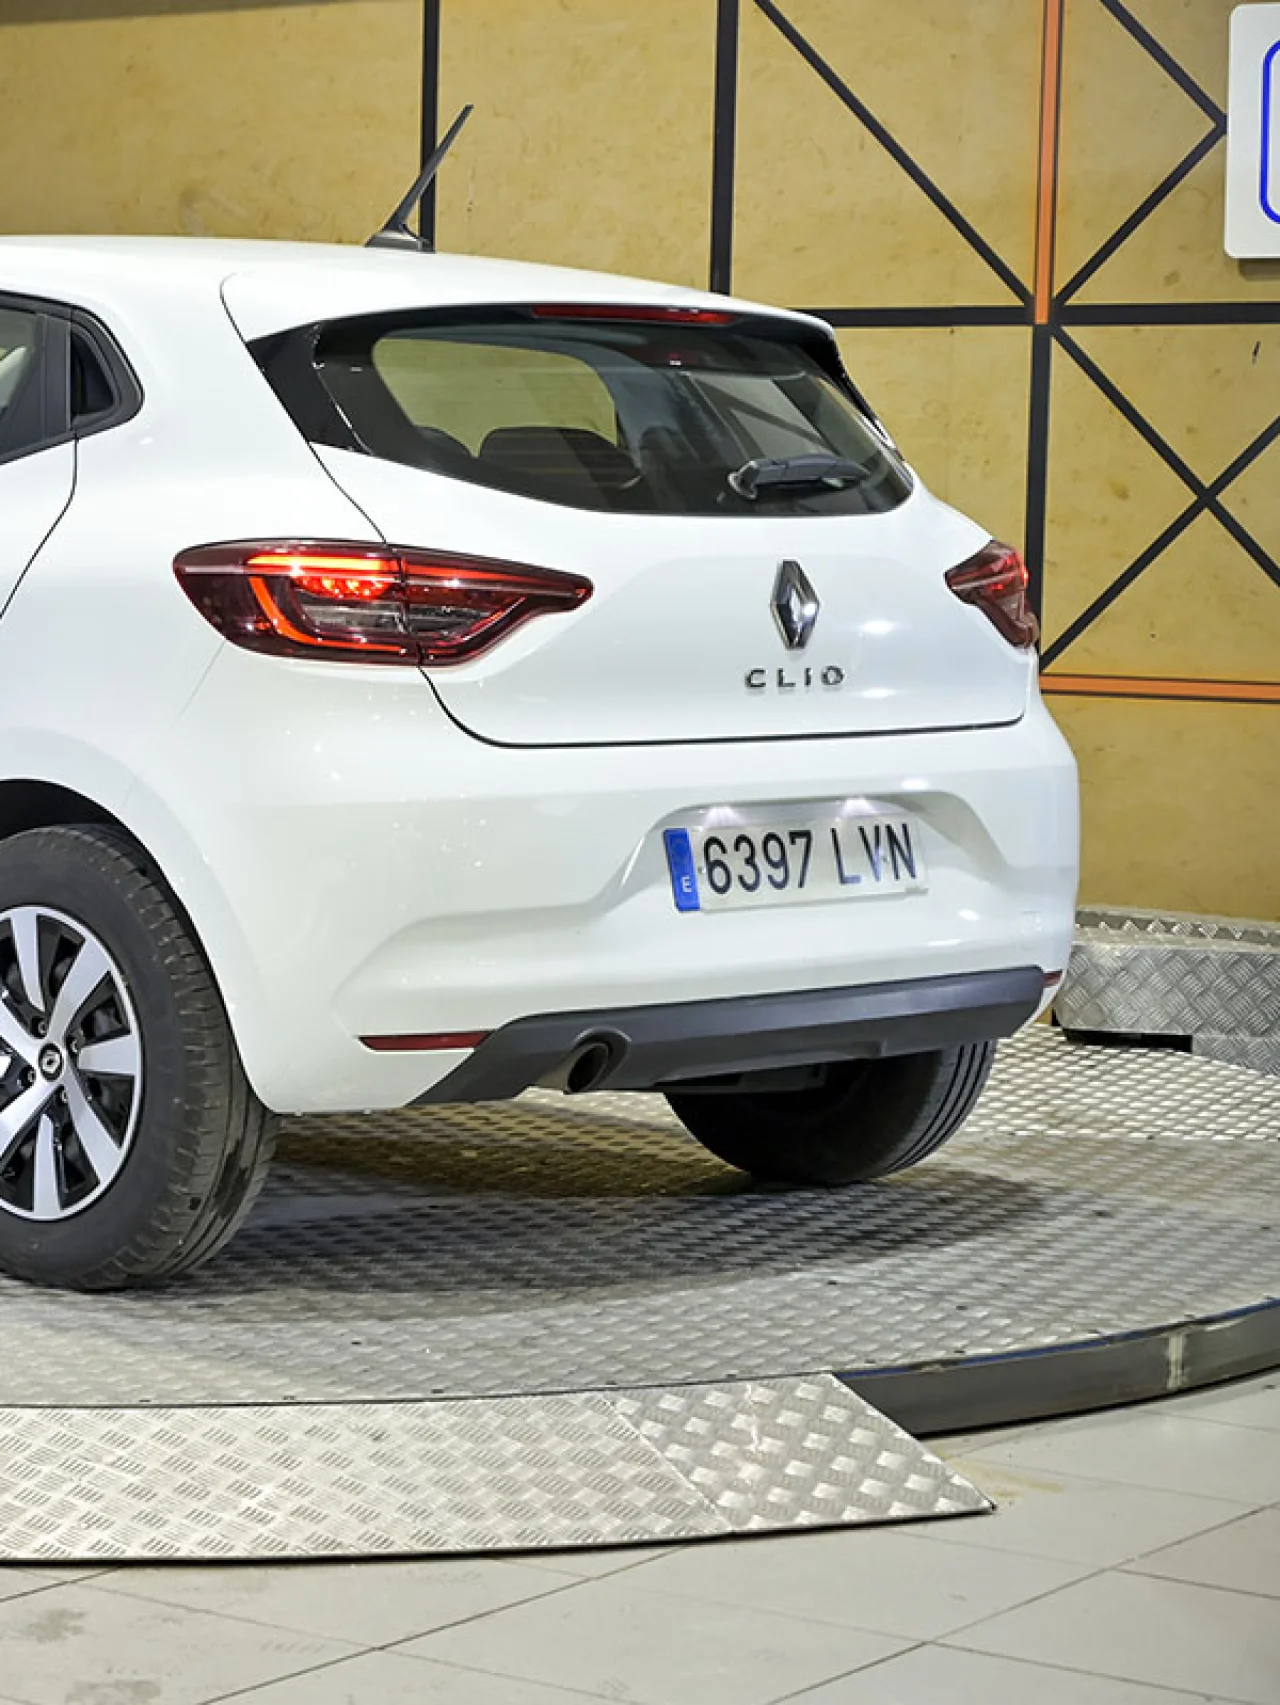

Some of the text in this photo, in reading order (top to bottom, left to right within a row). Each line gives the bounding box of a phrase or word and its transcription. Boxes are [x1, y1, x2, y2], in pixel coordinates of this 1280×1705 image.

[744, 665, 846, 689] CLIO
[703, 823, 917, 895] 6397 LVN
[681, 876, 692, 893] E
